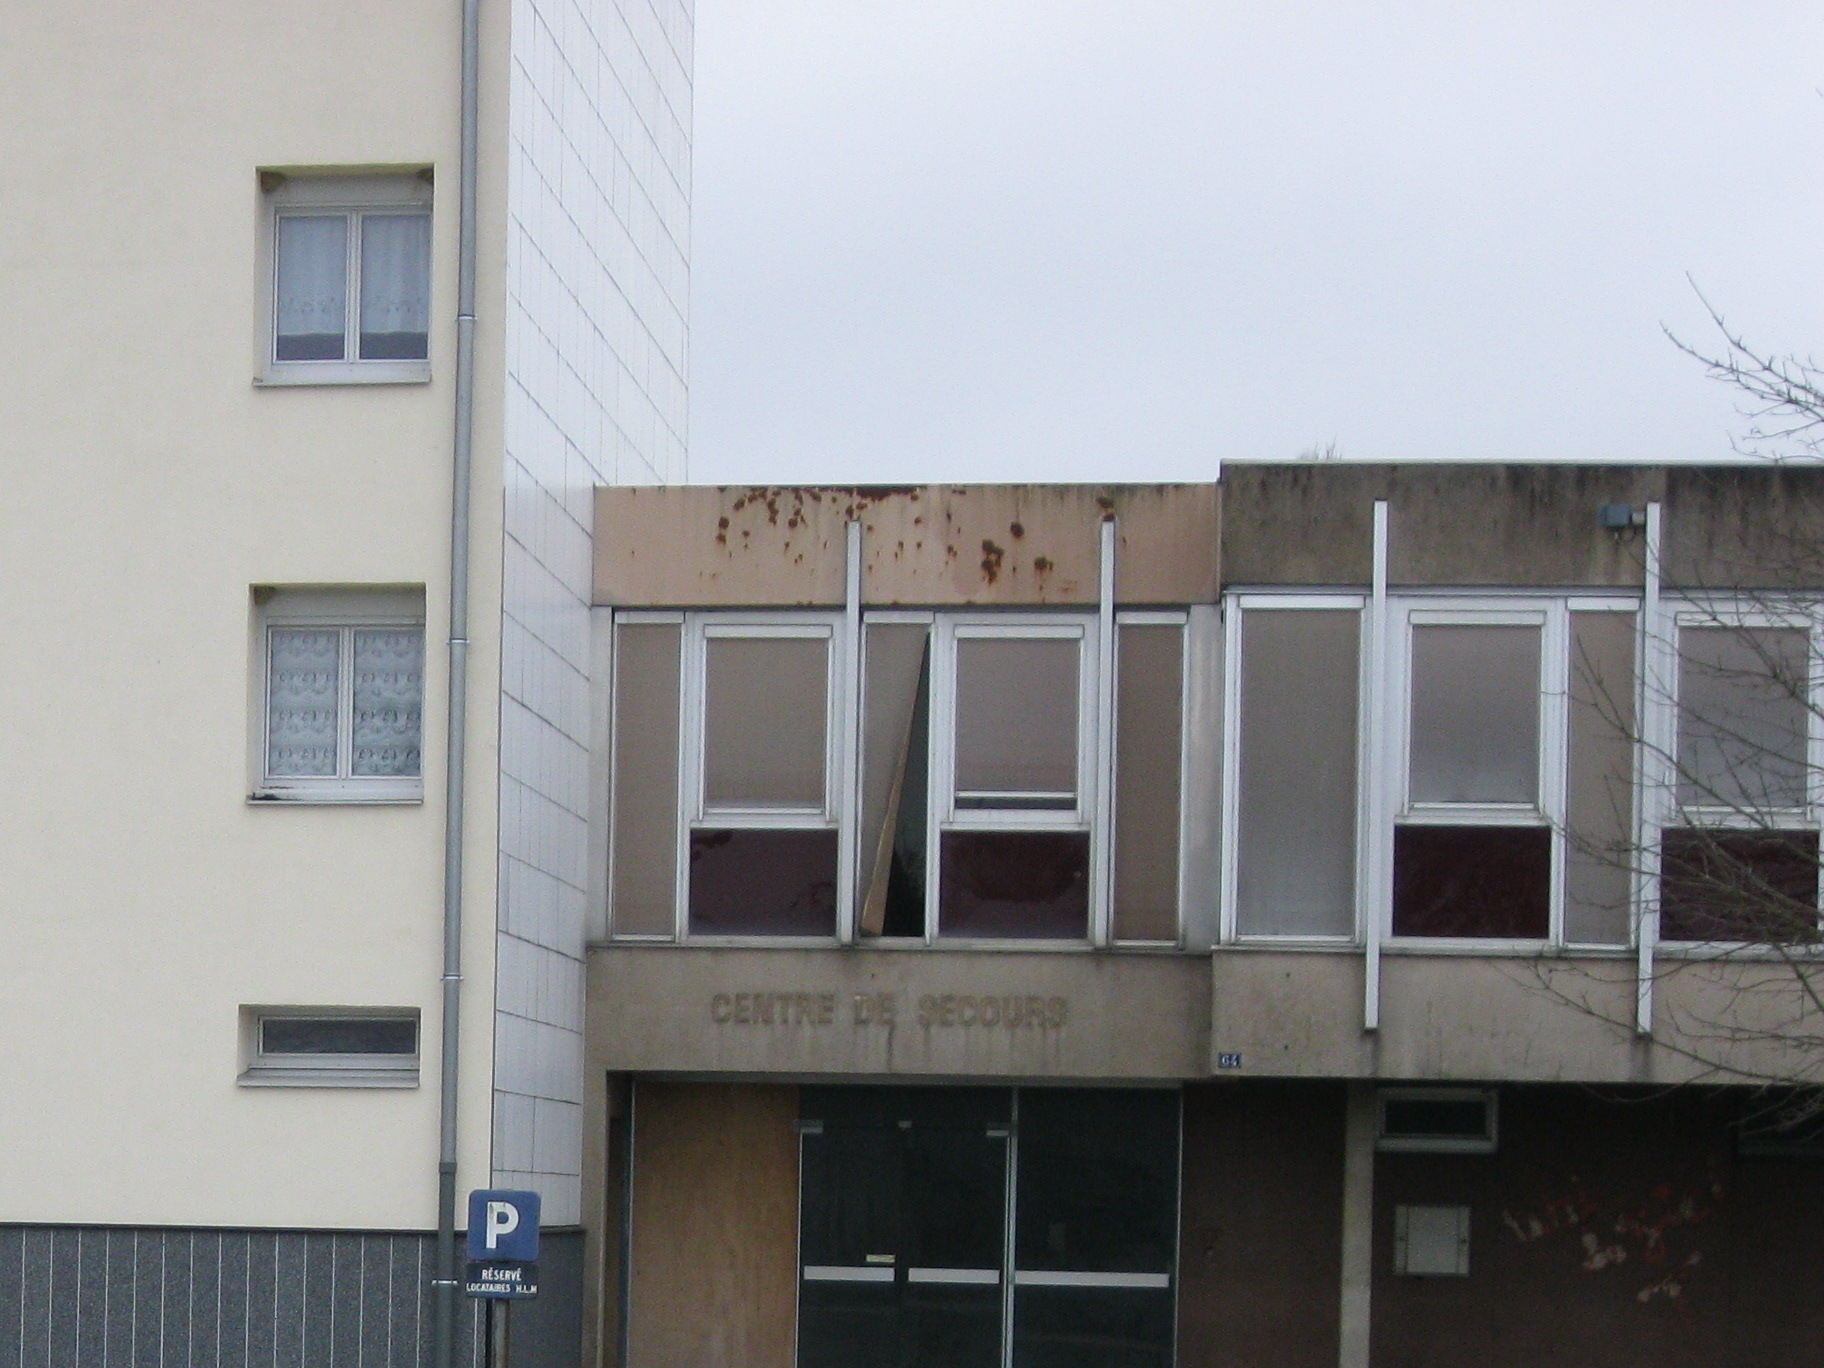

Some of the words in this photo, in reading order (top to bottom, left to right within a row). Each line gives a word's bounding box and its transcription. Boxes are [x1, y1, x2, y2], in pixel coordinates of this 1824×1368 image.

[711, 992, 835, 1025] CENTRE
[853, 993, 896, 1026] DE
[918, 994, 1069, 1030] SECOURS
[485, 1201, 519, 1249] P
[481, 1267, 522, 1281] RÉSERVÉ
